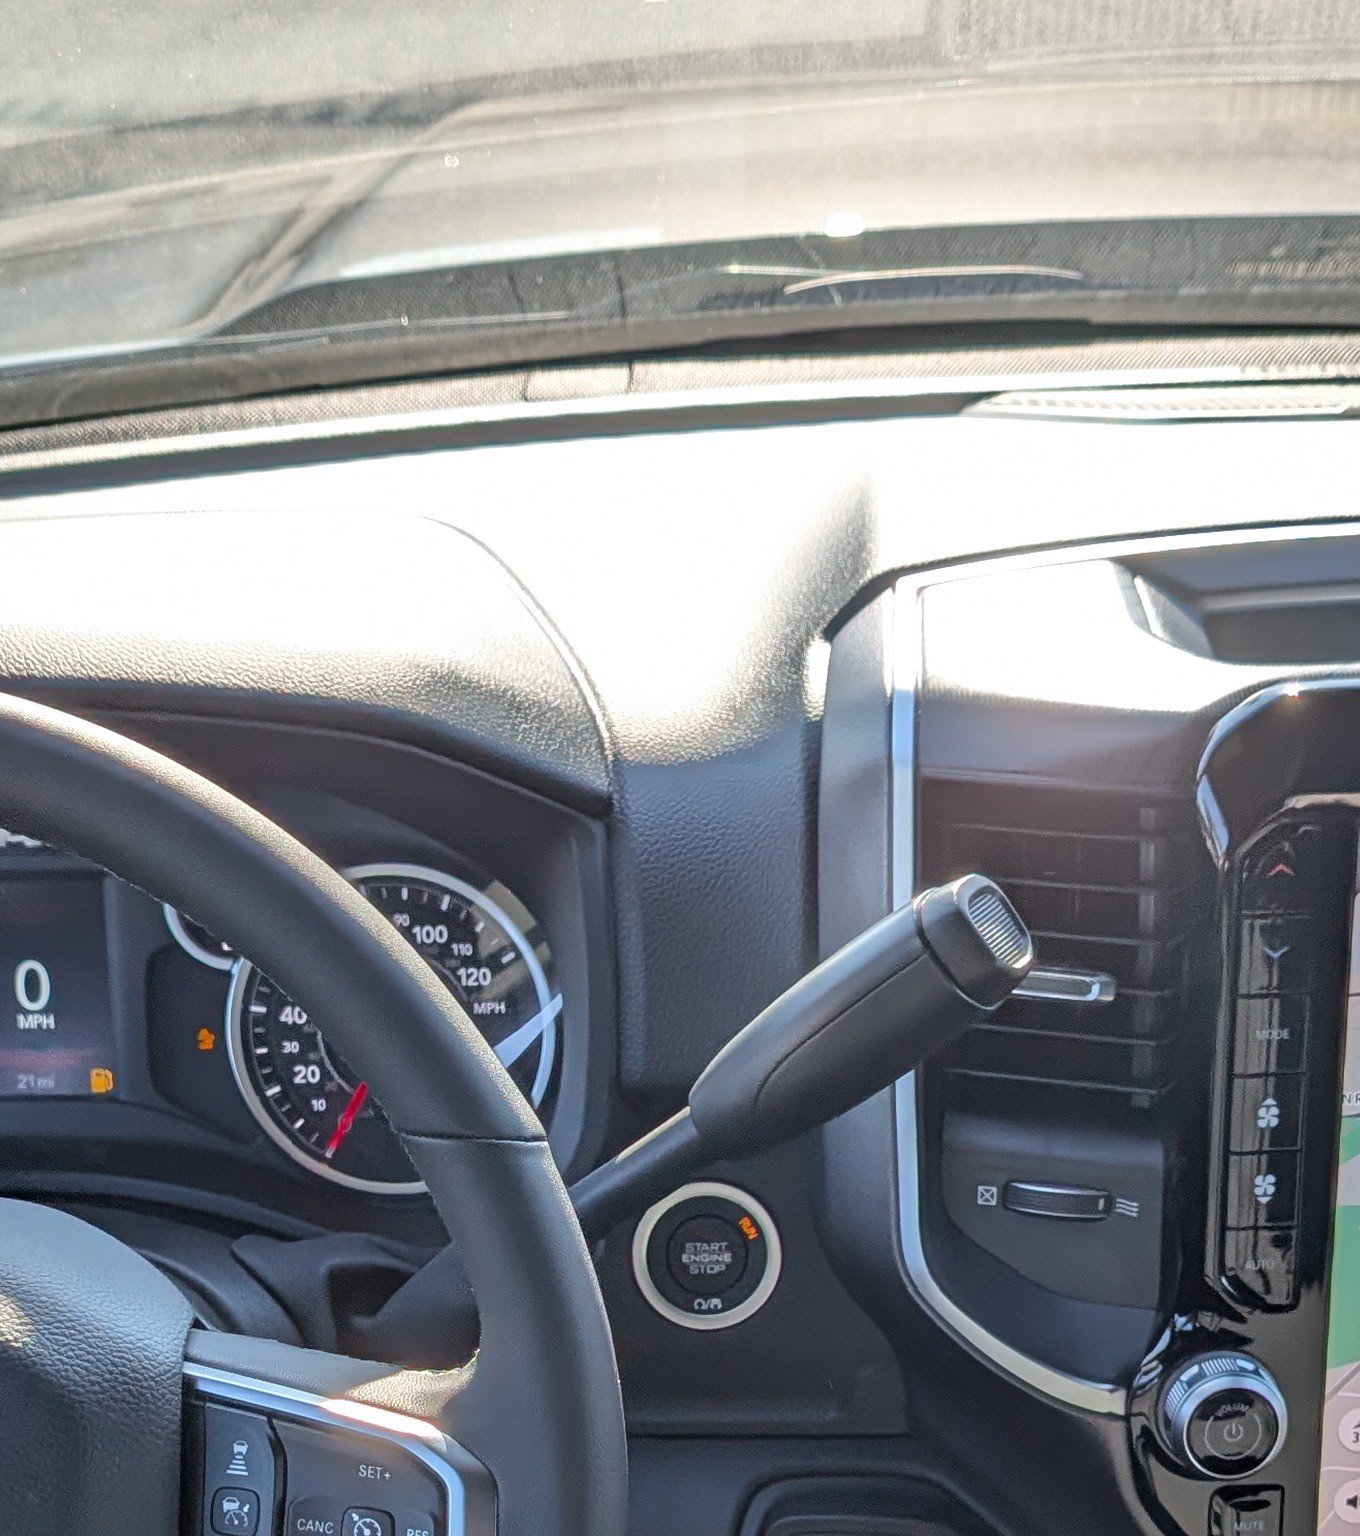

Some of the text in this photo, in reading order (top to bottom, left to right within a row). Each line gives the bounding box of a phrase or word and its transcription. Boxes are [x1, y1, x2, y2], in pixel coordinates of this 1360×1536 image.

[411, 924, 449, 945] 100
[13, 959, 51, 1011] 0
[456, 966, 492, 987] 120
[278, 1005, 308, 1025] 40
[472, 1001, 506, 1015] MPH
[16, 1013, 55, 1030] MPH
[292, 1064, 321, 1085] 20
[311, 1098, 327, 1112] 10
[684, 1242, 728, 1252] START
[681, 1252, 732, 1263] ENGINE
[689, 1264, 727, 1275] STOP
[296, 1518, 334, 1536] CANC
